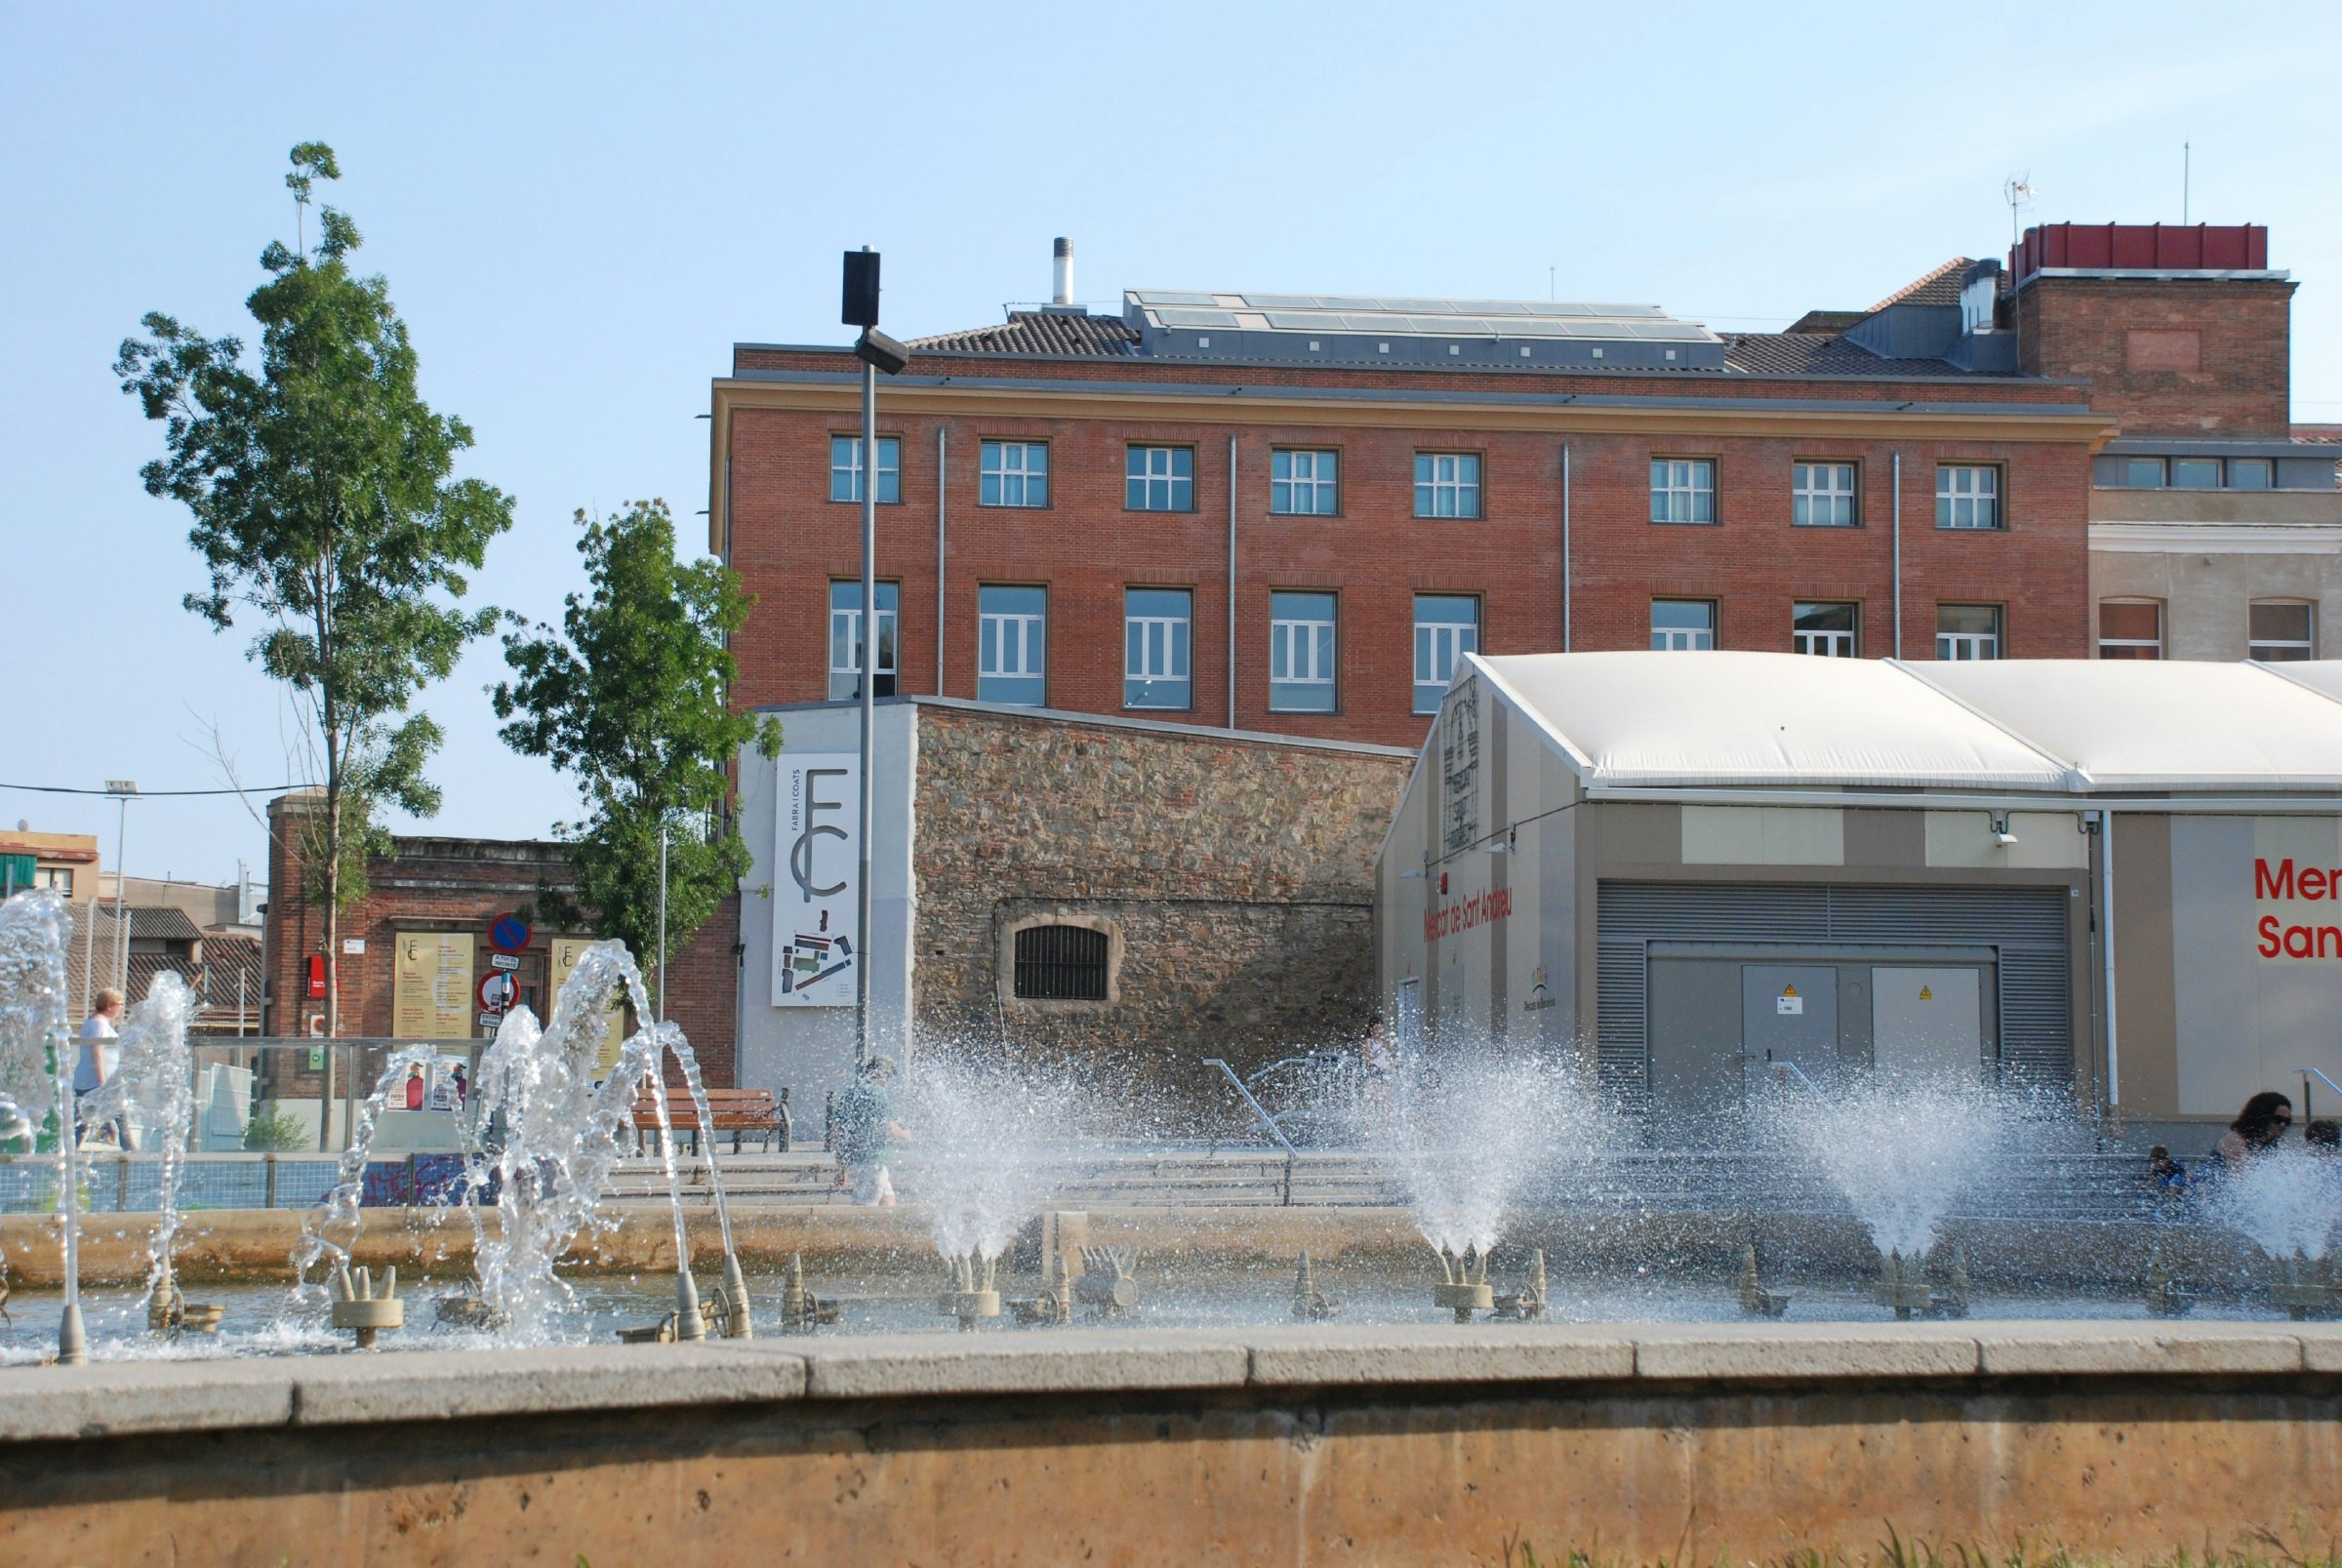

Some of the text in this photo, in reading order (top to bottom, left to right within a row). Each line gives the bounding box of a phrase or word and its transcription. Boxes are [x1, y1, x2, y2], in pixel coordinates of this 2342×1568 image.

[2254, 858, 2342, 901] Mer
[1424, 882, 1513, 944] Mercat de Sant Andreu
[2257, 915, 2342, 958] San
